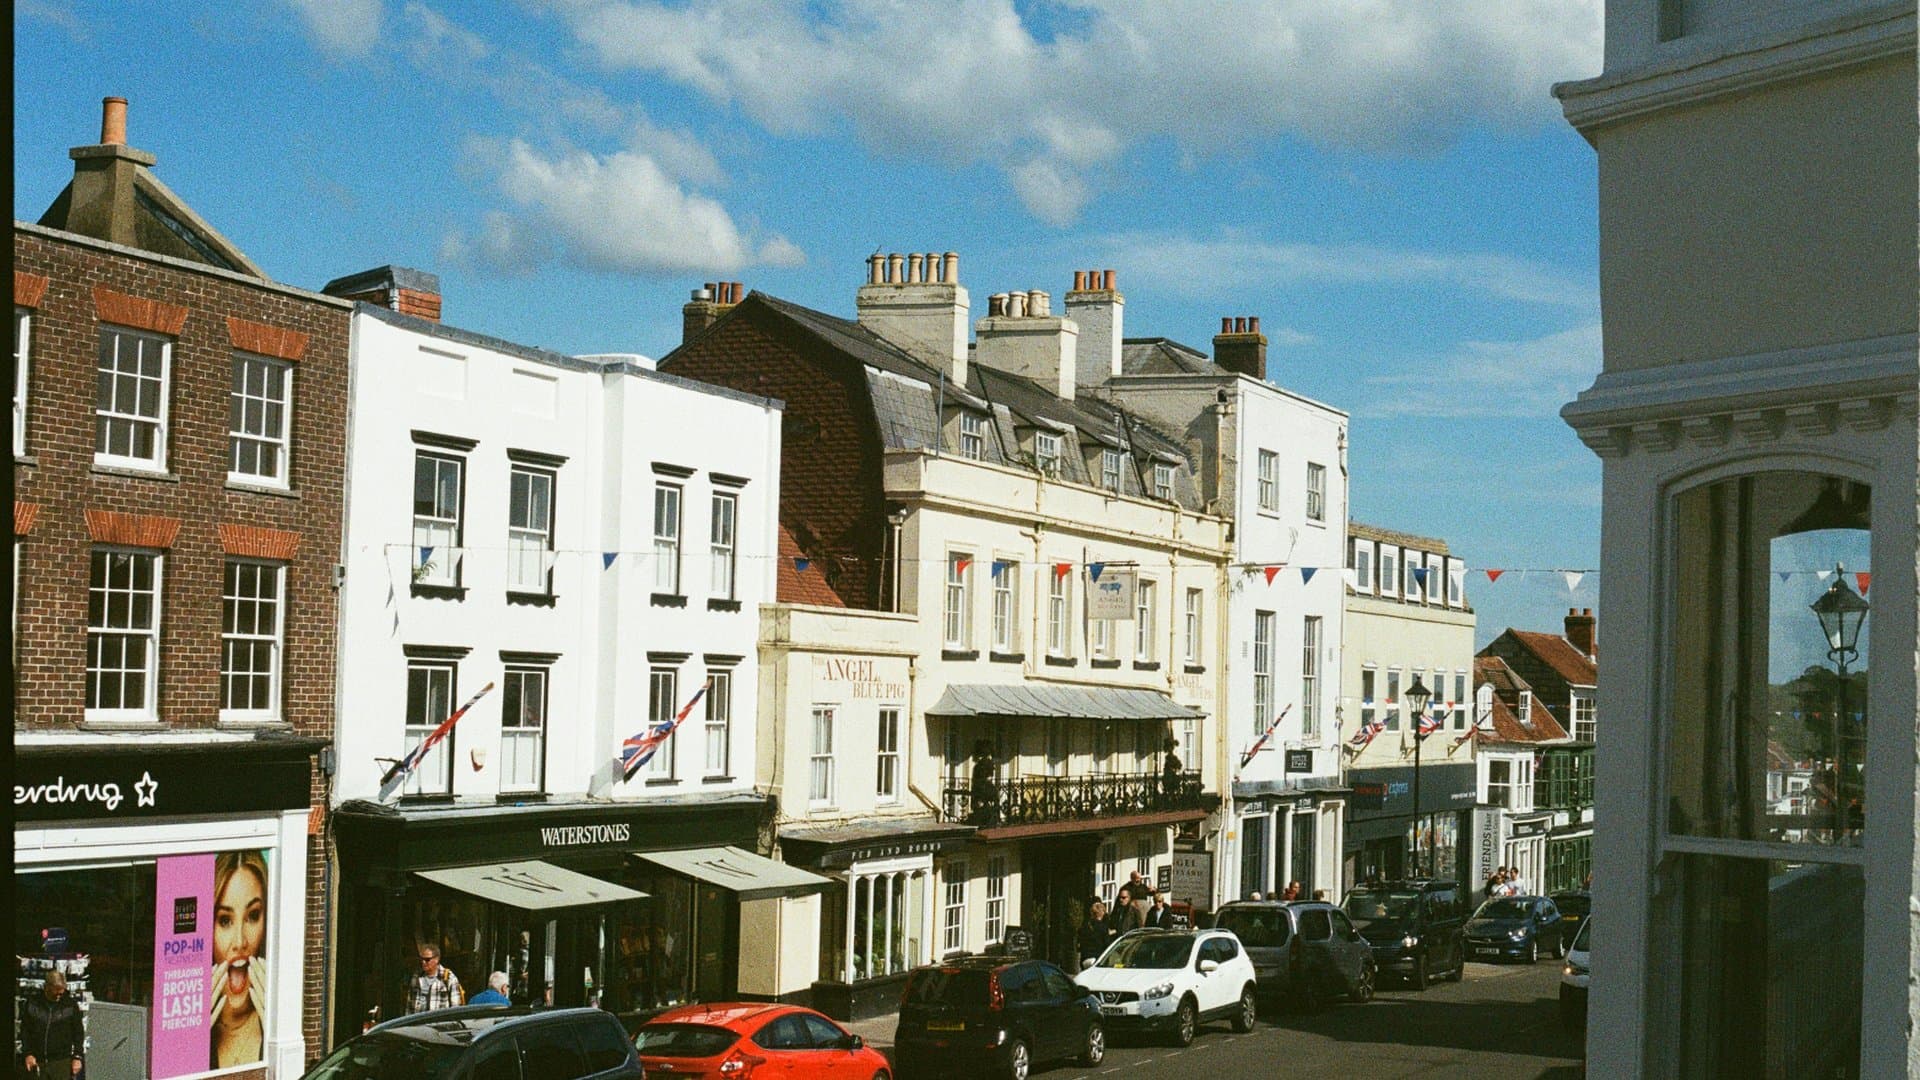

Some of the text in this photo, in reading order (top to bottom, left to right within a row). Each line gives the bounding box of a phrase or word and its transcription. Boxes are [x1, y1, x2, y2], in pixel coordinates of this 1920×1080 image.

[823, 659, 874, 681] ANGEL
[853, 682, 905, 699] BLUE PIG
[541, 823, 630, 846] WATERSTONES
[880, 846, 901, 857] AND
[1481, 832, 1491, 881] FRIENDS
[163, 938, 205, 955] POP-IN
[164, 967, 204, 980] THREADING
[163, 979, 204, 996] BROWS
[162, 994, 204, 1018] LASH
[162, 1016, 202, 1031] PIERCING
